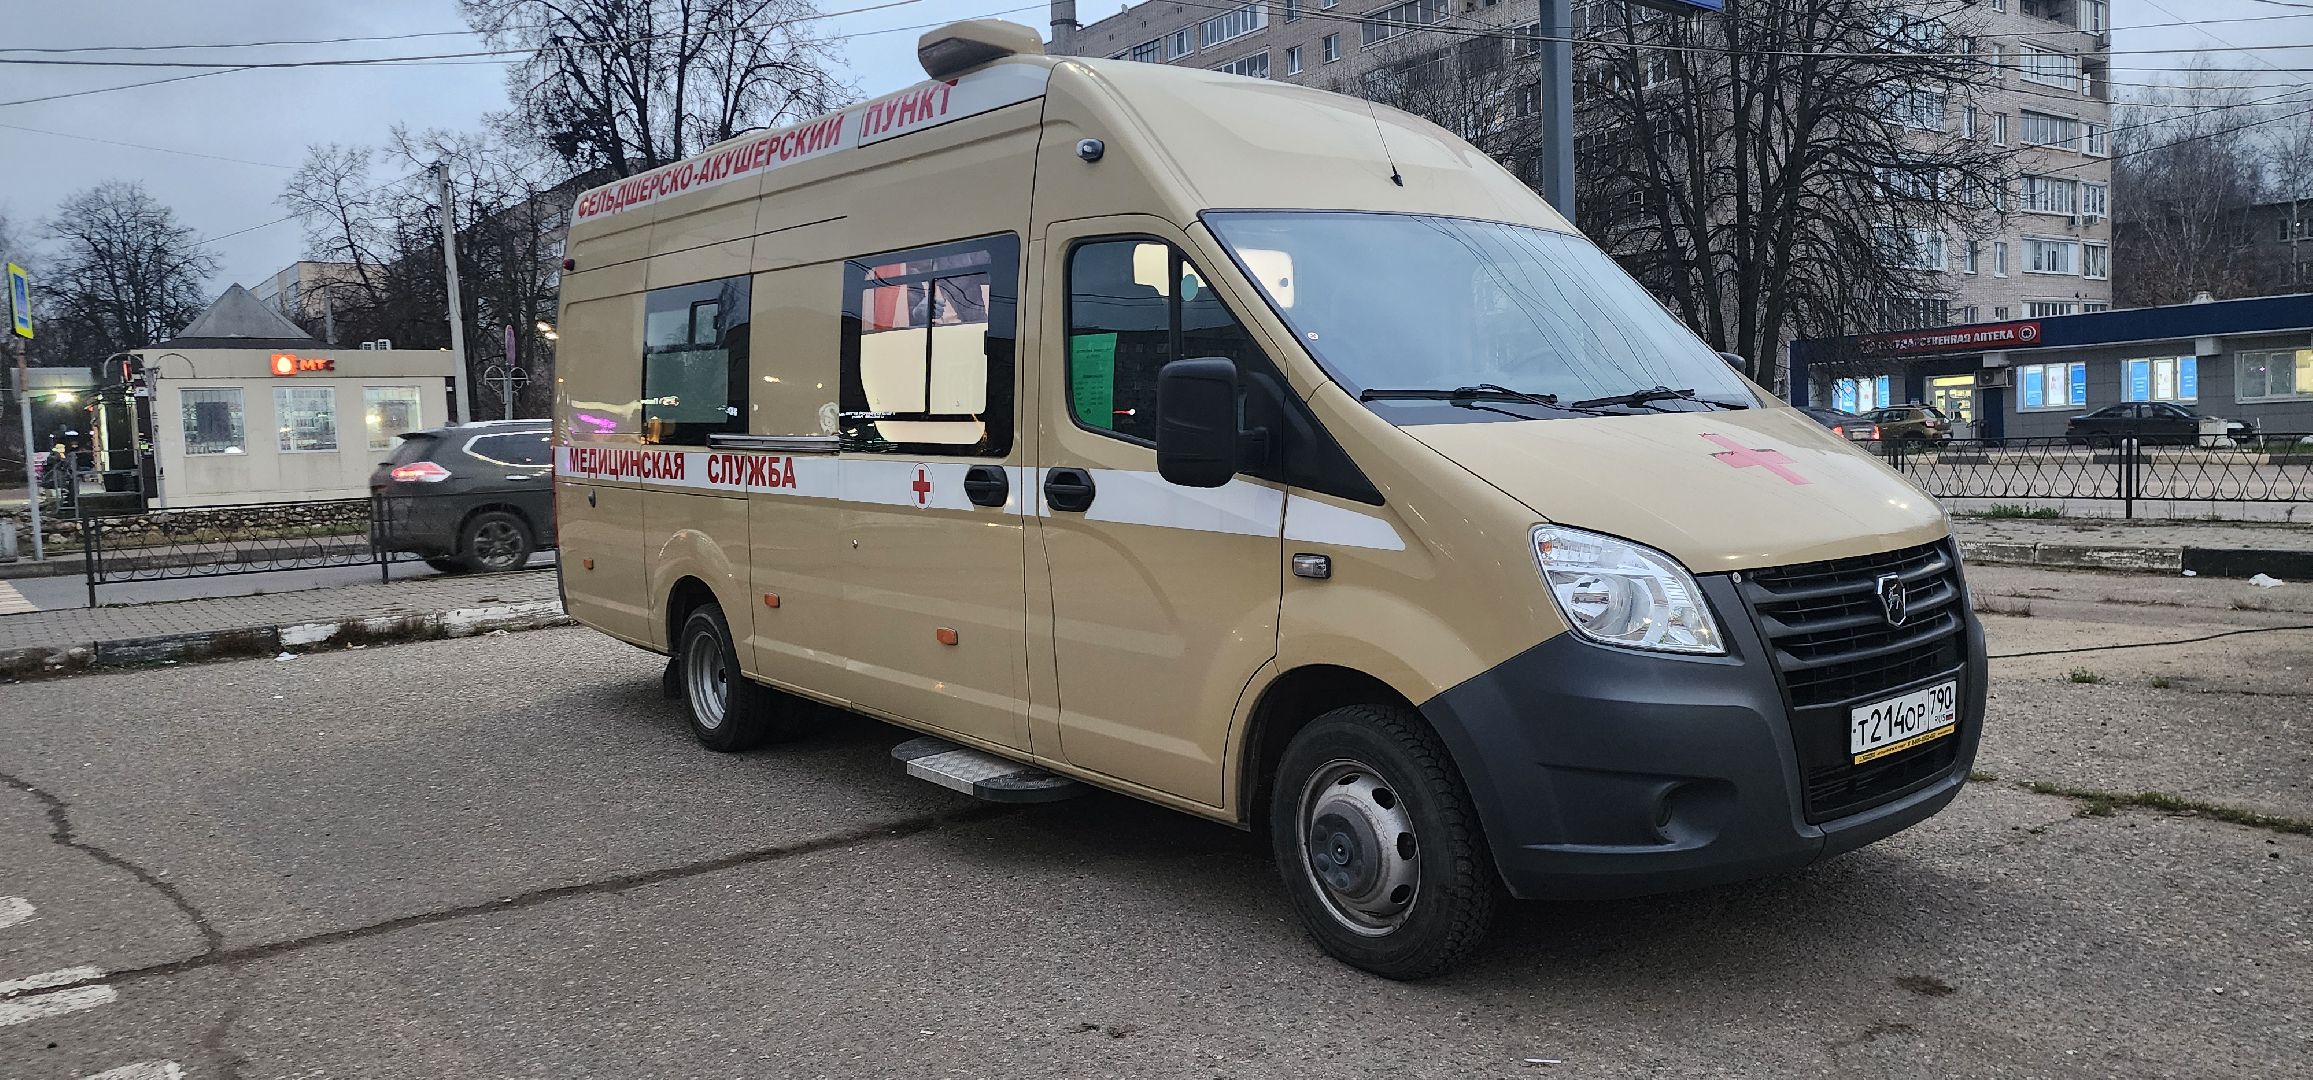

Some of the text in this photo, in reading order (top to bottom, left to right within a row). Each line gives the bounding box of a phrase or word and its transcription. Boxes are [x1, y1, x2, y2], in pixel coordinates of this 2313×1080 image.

[861, 79, 959, 138] ПУНКТ
[1973, 329, 2015, 343] АПТЕКА
[299, 358, 335, 371] МТС
[568, 447, 797, 490] МЕДИЦИНСКАЯ СЛУЖБА
